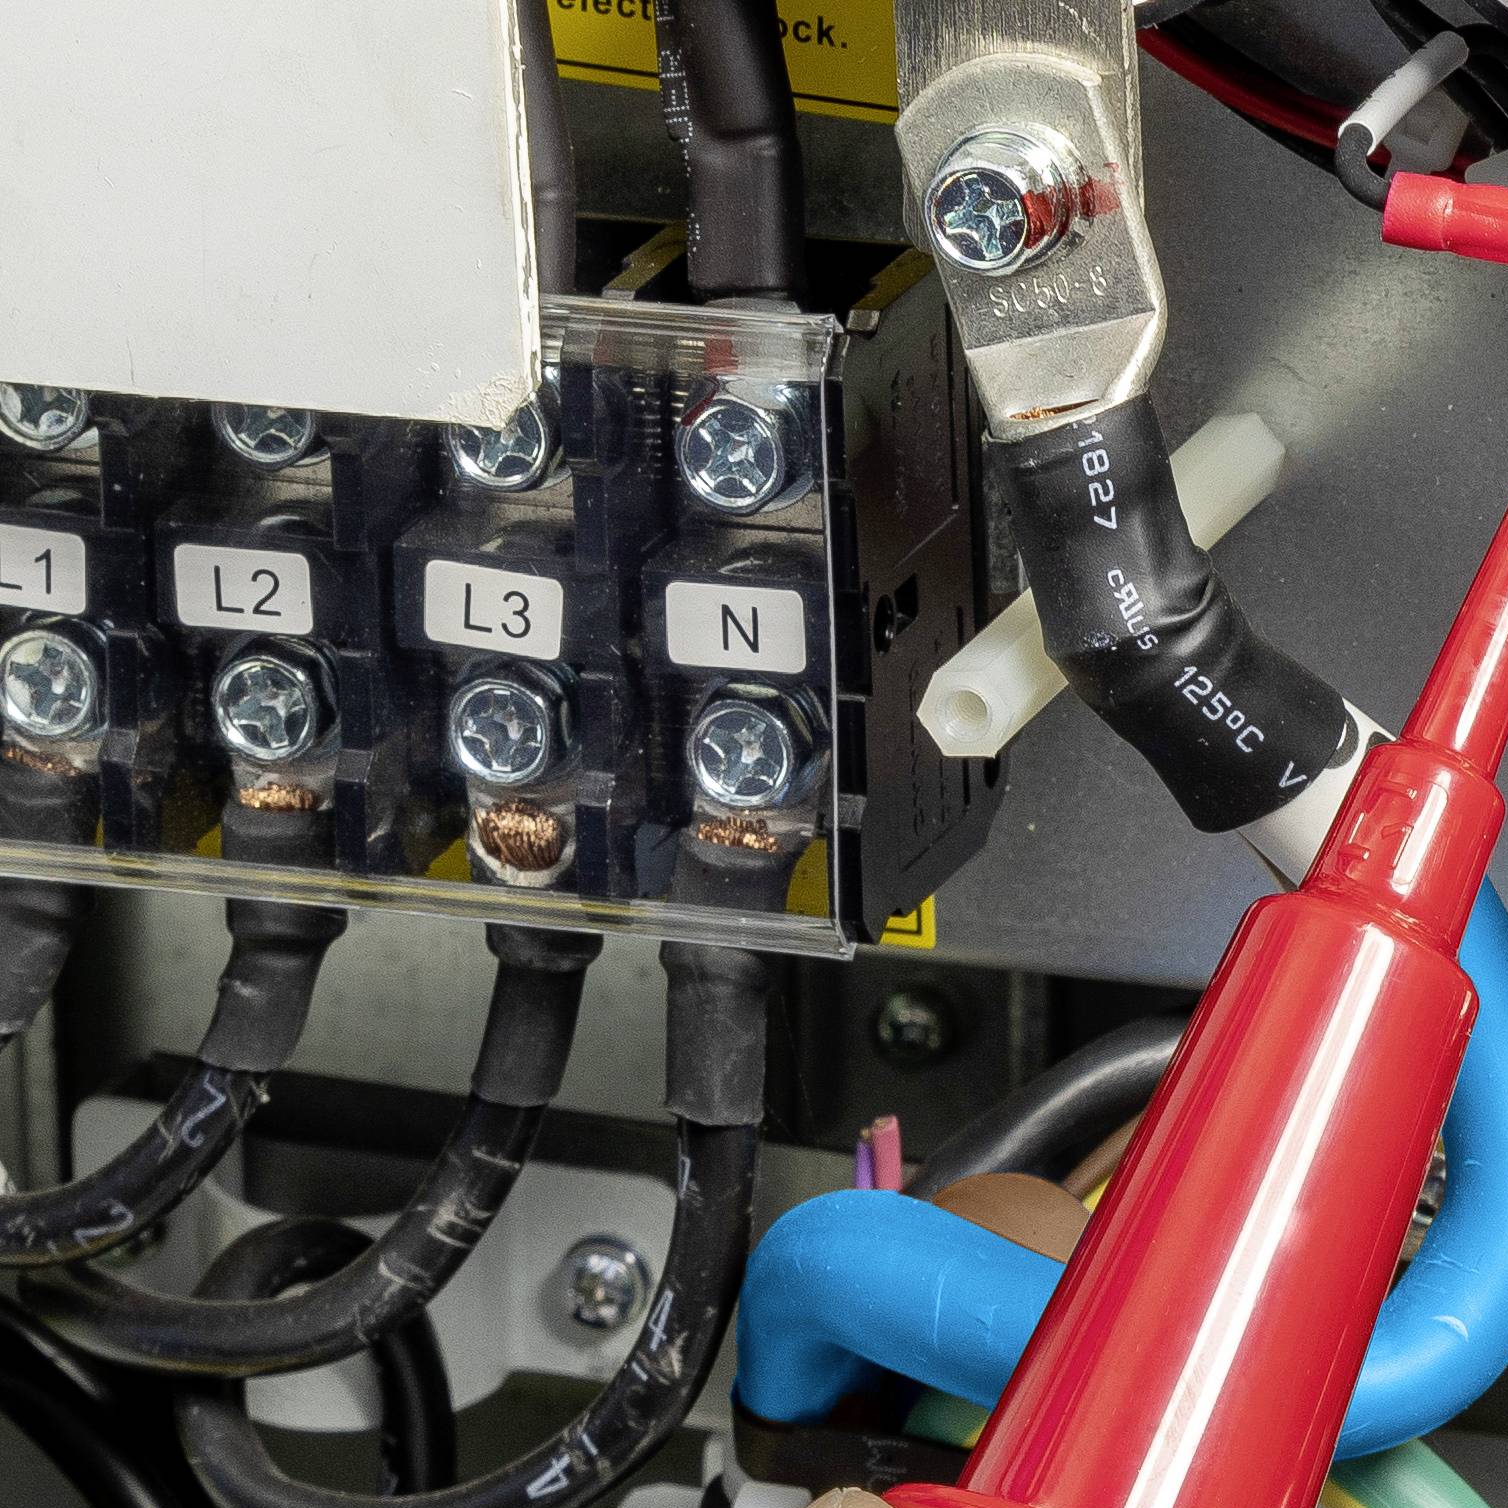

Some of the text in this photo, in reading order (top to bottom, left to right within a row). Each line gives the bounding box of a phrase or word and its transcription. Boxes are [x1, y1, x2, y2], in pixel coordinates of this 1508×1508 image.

[212, 564, 282, 617] L2
[462, 583, 531, 638] L3
[722, 603, 760, 653] N
